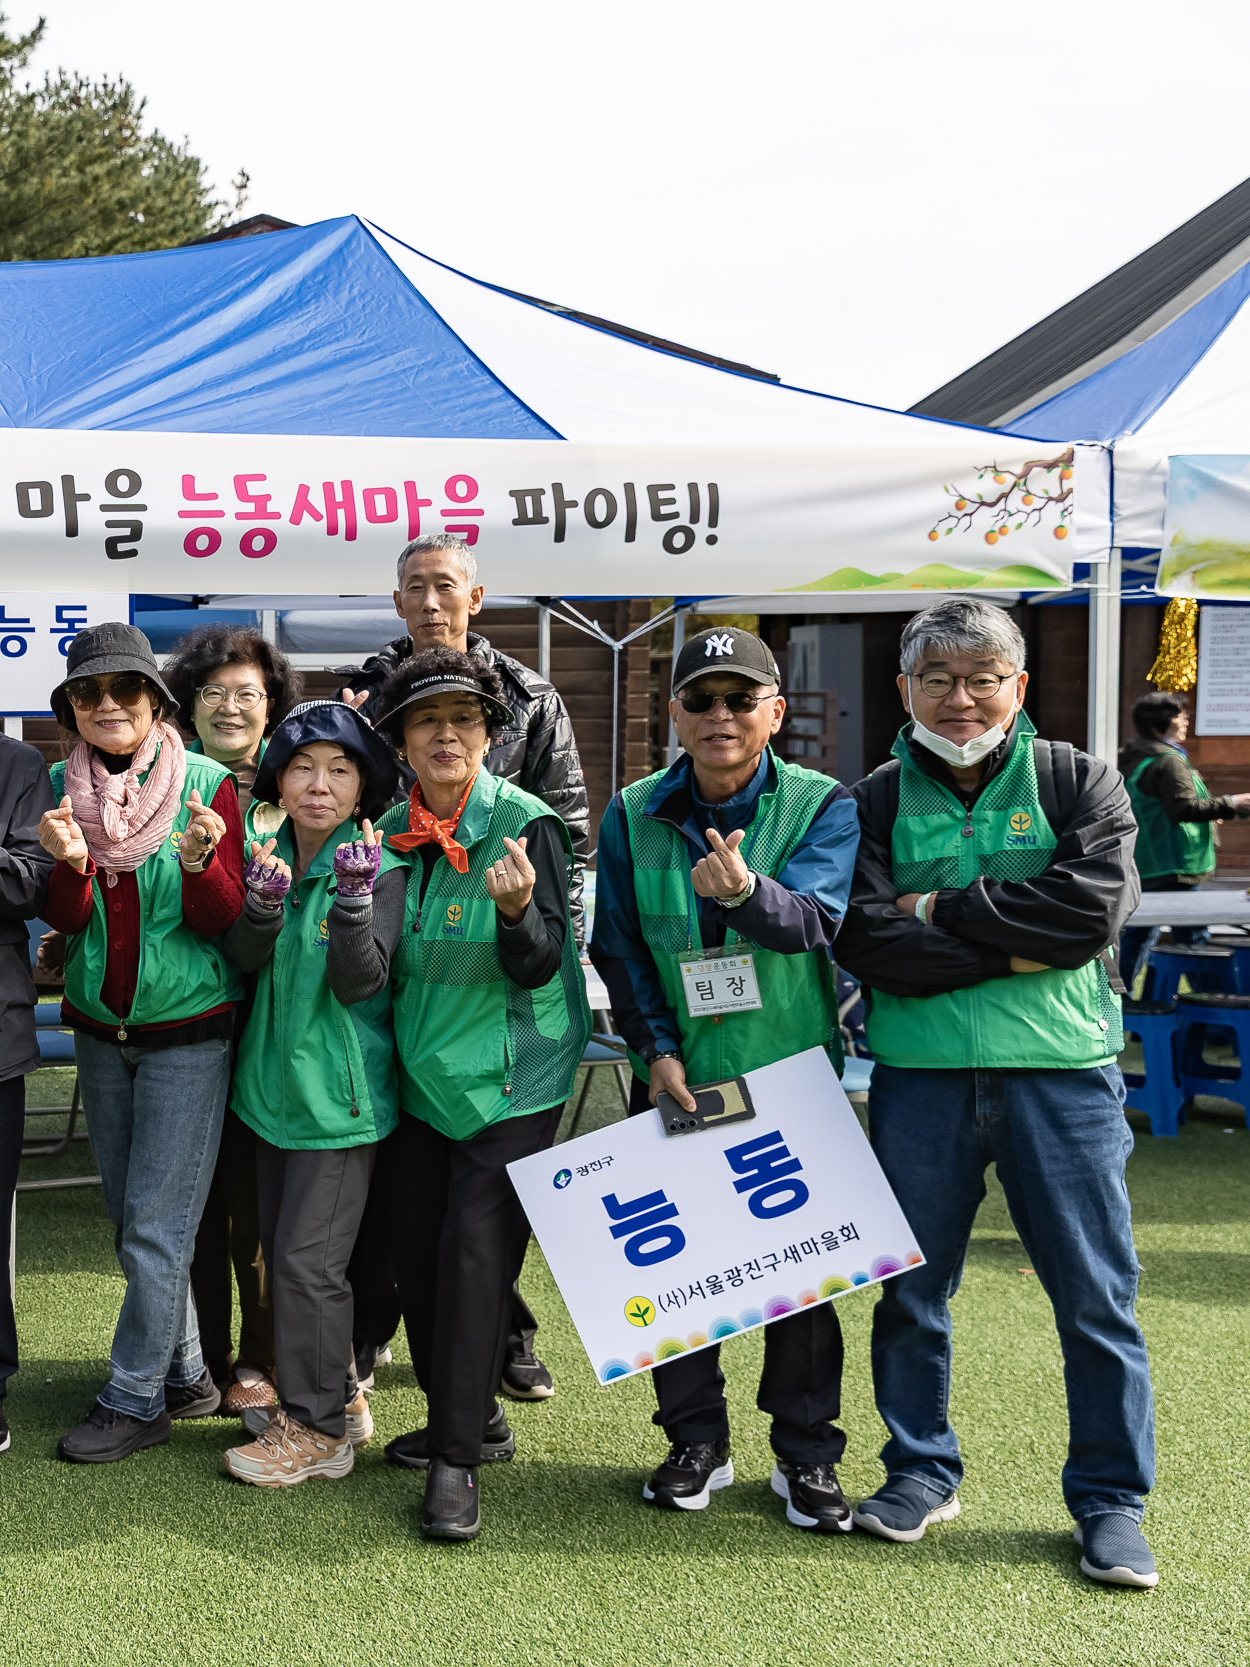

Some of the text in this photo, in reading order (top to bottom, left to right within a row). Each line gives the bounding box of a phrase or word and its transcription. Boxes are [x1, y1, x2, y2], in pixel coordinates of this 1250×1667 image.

[16, 468, 148, 560] 마을
[508, 482, 720, 555] 파이팅!
[704, 633, 735, 658] NY
[410, 674, 476, 690] PROVIDA NATURAL
[1005, 835, 1038, 847] SMU
[442, 924, 465, 937] SMU
[312, 937, 330, 948] SM
[575, 1155, 615, 1177] 광진구
[658, 1221, 861, 1313] (사)서울광진구새마을회
